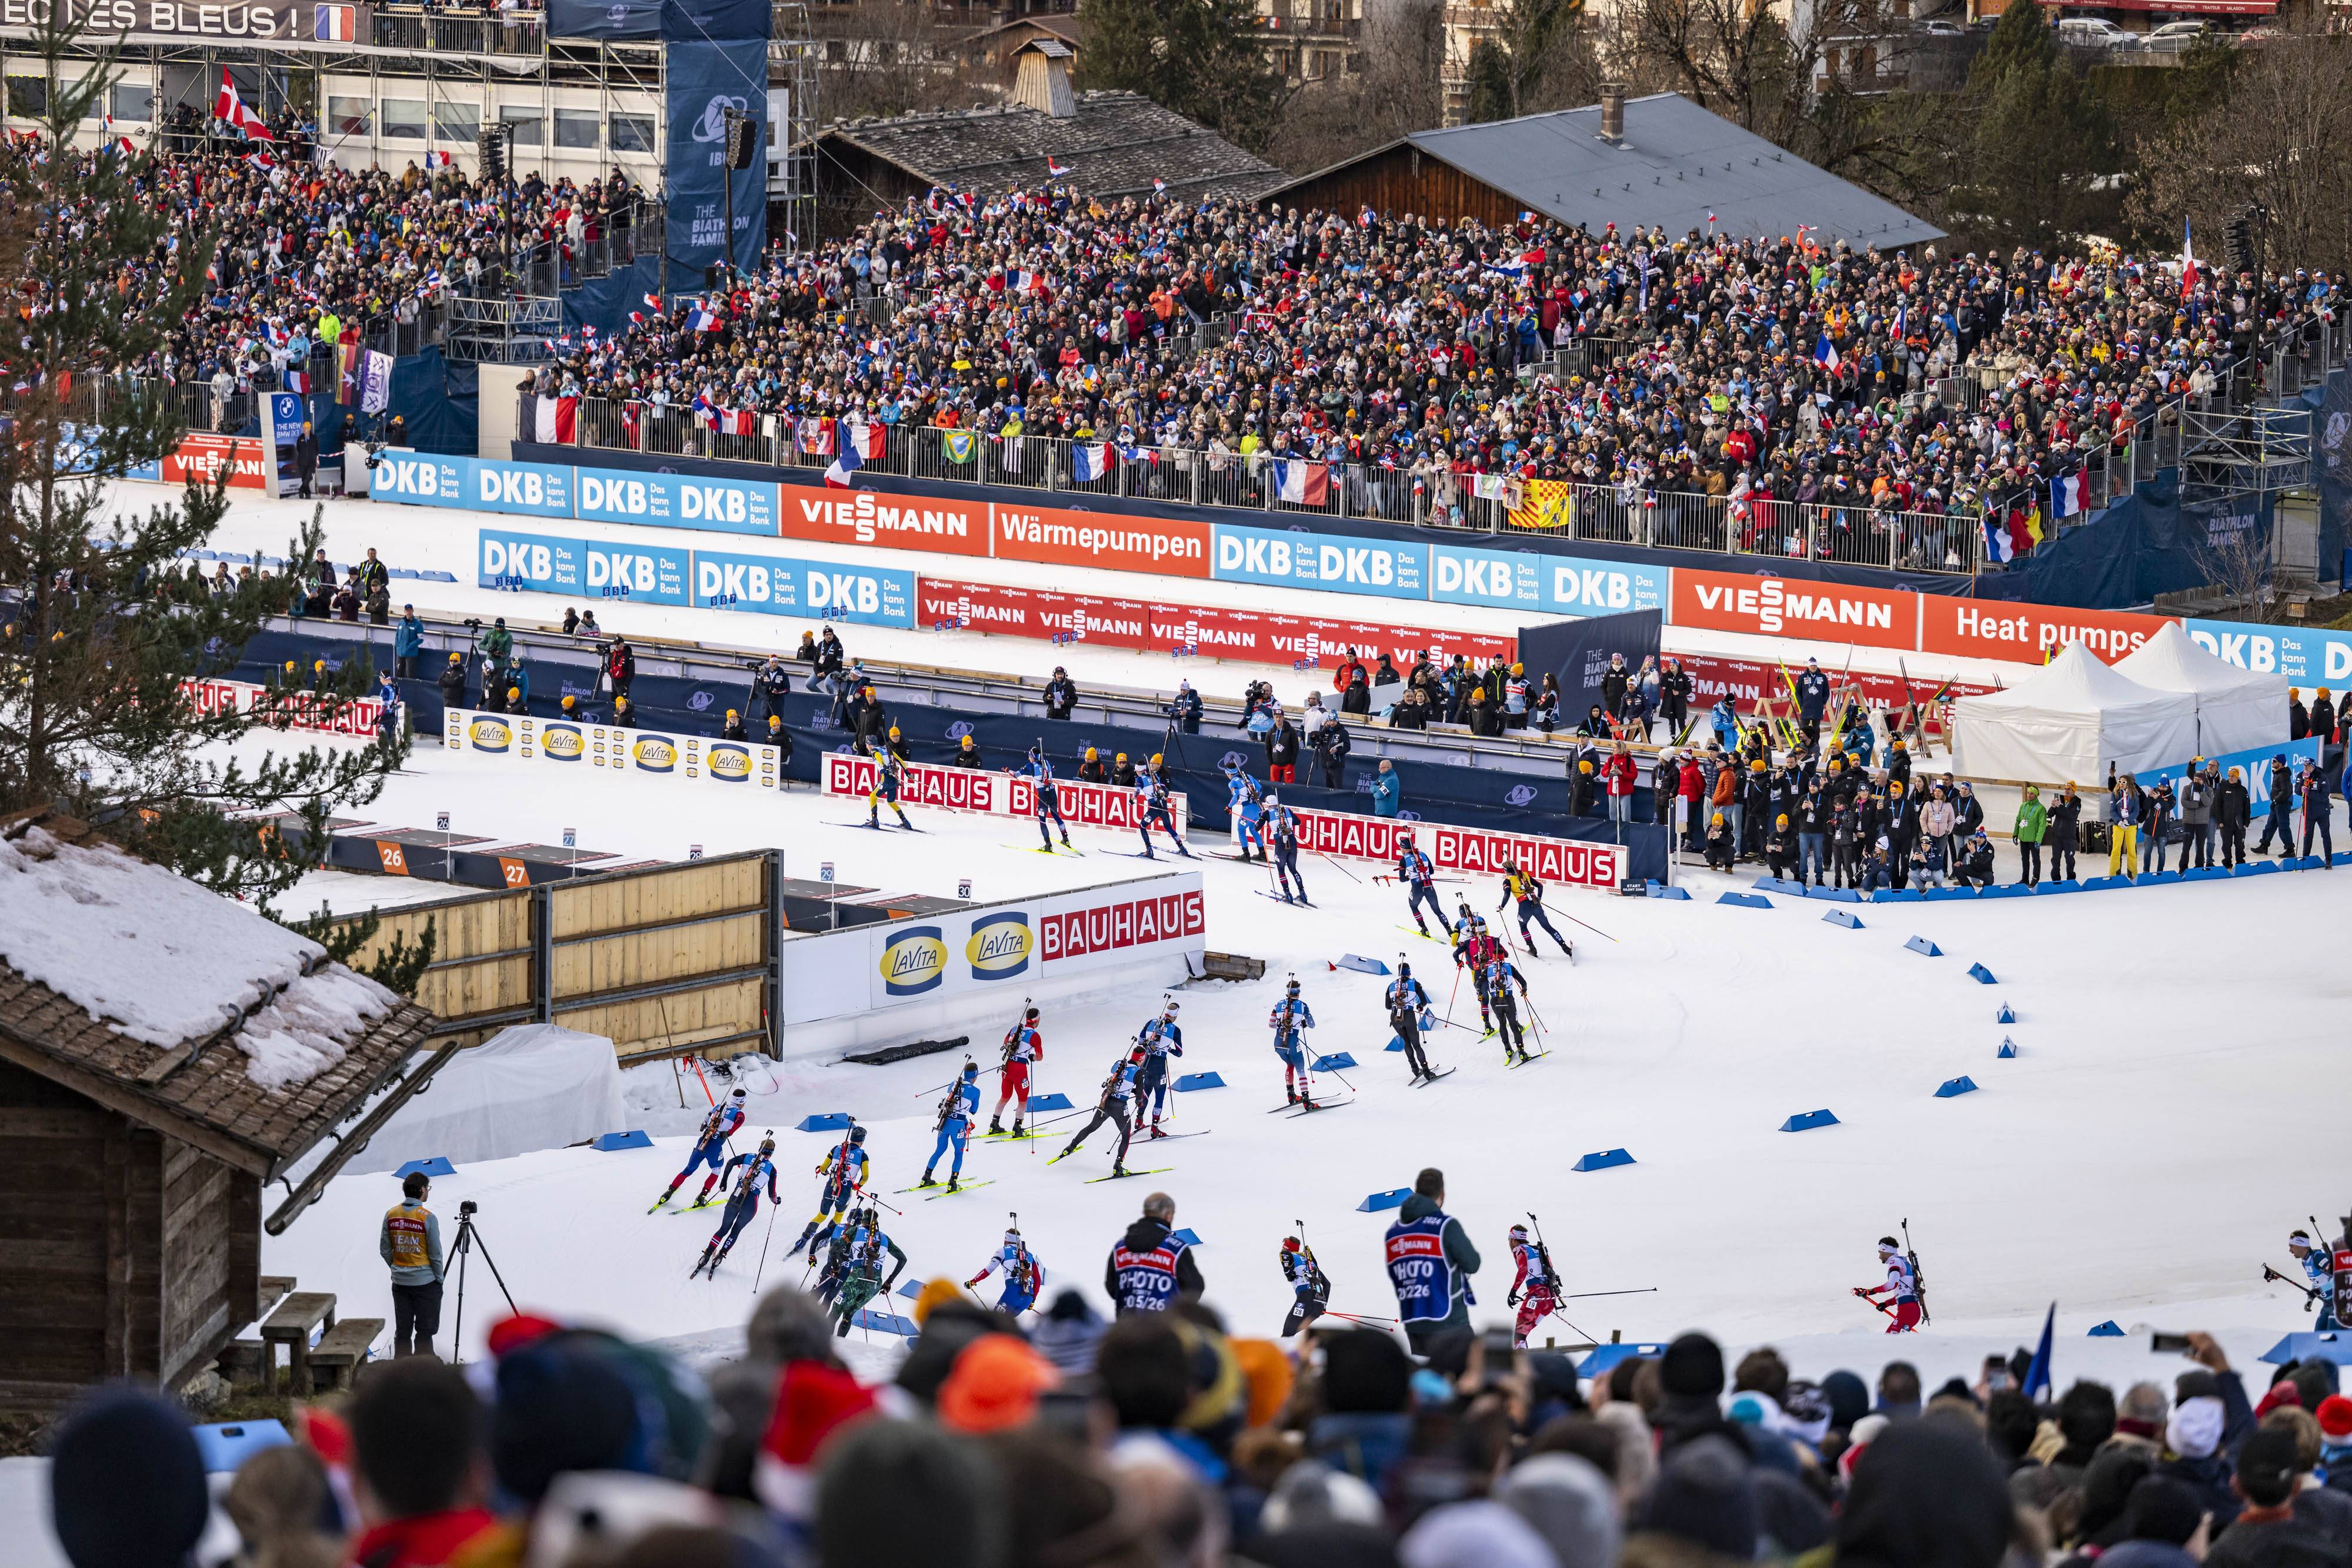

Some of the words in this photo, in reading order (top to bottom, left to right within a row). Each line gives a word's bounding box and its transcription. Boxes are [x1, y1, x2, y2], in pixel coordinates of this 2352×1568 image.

[151, 2, 276, 36] BLEUS
[290, 8, 298, 38] !
[696, 205, 716, 218] THE
[2327, 456, 2340, 467] IBU
[442, 465, 456, 475] Das
[376, 459, 437, 495] DKB
[442, 476, 459, 486] kann
[547, 474, 561, 484] Das
[441, 487, 459, 498] Bank
[480, 469, 543, 505] DKB
[547, 485, 564, 496] kann
[650, 483, 665, 494] Das
[547, 496, 565, 507] Bank
[583, 477, 646, 514] DKB
[651, 494, 669, 505] kann
[750, 492, 764, 502] Das
[681, 486, 746, 522] DKB
[750, 503, 769, 513] kann
[651, 506, 669, 516] Bank
[750, 514, 769, 524] Bank
[800, 494, 967, 541] VIESSMANN
[1001, 513, 1201, 560] Wärmepumpen
[556, 547, 571, 559] Das
[1297, 543, 1312, 554] Das
[485, 540, 552, 580] DKB
[1220, 535, 1291, 575] DKB
[1297, 555, 1317, 567] kann
[1398, 553, 1414, 564] Das
[556, 560, 575, 571] kann
[660, 558, 676, 569] Das
[1320, 546, 1393, 585] DKB
[1518, 564, 1534, 575] Das
[587, 551, 655, 591] DKB
[660, 570, 680, 582] kann
[775, 568, 790, 579] Das
[1296, 567, 1317, 579] Bank
[1398, 564, 1418, 576] kann
[1438, 556, 1512, 596] DKB
[517, 576, 520, 584] 1
[556, 572, 576, 584] Bank
[700, 561, 770, 601] DKB
[1398, 577, 1419, 588] Bank
[1518, 576, 1538, 587] kann
[1636, 575, 1653, 587] Das
[660, 583, 680, 594] Bank
[775, 580, 794, 592] kann
[884, 580, 900, 591] Das
[1555, 567, 1630, 608] DKB
[808, 571, 878, 613] DKB
[884, 592, 904, 604] kann
[1518, 588, 1539, 600] Bank
[1635, 589, 1656, 600] kann
[775, 593, 795, 604] Bank
[841, 607, 847, 615] 10
[884, 604, 905, 617] Bank
[1695, 580, 1890, 631] VIESSMANN
[822, 609, 828, 617] 12
[832, 608, 838, 616] 11
[926, 597, 1024, 629] VIESSMANN
[936, 622, 941, 630] 15
[956, 618, 962, 627] 13
[1040, 610, 1141, 642] VIESSMANN
[1071, 632, 1078, 641] 16
[1151, 621, 1255, 651] VIESSMANN
[1958, 607, 2029, 641] Heat
[2039, 617, 2145, 657] pumps
[2282, 638, 2301, 650] Das
[1587, 649, 1602, 662] THE
[2281, 653, 2305, 663] kann
[2281, 664, 2306, 676] Bank
[561, 687, 592, 696] BIATHLON
[814, 709, 826, 717] THE
[1359, 772, 1372, 781] THE
[834, 764, 989, 805] BAHAUS
[439, 818, 448, 829] 26
[564, 834, 574, 846] 27
[384, 849, 401, 866] 26
[690, 851, 702, 860] 28
[1439, 830, 1615, 886] BAUHAUS
[507, 865, 525, 882] 27
[821, 868, 833, 880] 29
[958, 886, 970, 898] 30
[1044, 900, 1202, 955] BAUHAUS
[1553, 932, 1562, 941] NOR
[390, 1219, 423, 1230] VIESSMANN
[1422, 1216, 1442, 1225] 2024
[393, 1235, 420, 1245] TEAM
[724, 1236, 733, 1249] NOR
[1118, 1271, 1172, 1293] PHOTO
[835, 1295, 841, 1303] 23
